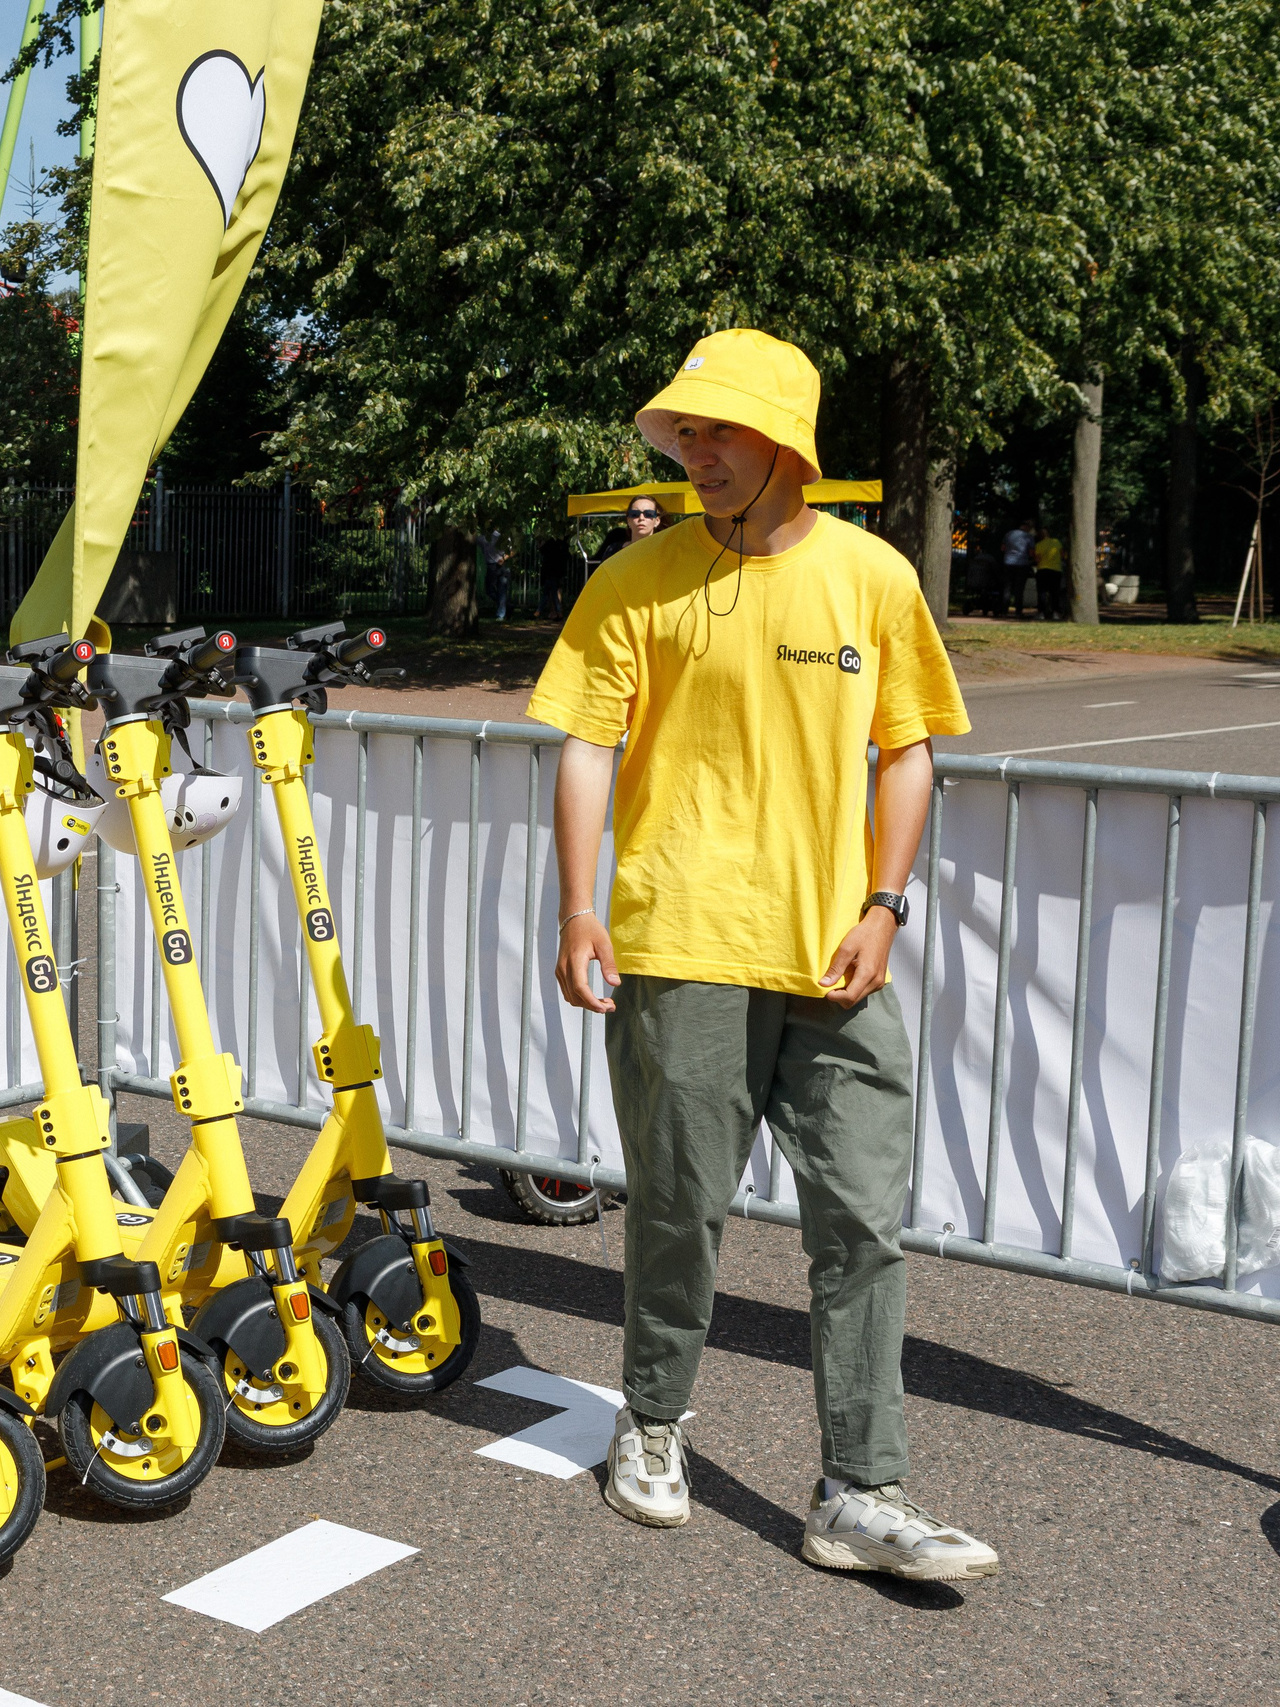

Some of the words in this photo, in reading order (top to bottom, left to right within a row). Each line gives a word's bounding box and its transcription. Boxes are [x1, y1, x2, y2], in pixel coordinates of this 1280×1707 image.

[222, 637, 229, 647] Я
[373, 634, 380, 643] Я
[80, 646, 88, 656] Я
[776, 644, 835, 665] Яндекс
[841, 650, 860, 670] Go
[297, 836, 322, 905] Яндекс
[311, 912, 330, 939] Go
[152, 853, 178, 926] Яндекс
[167, 933, 187, 962] Go
[13, 874, 42, 952] Яндекс
[31, 959, 51, 990] Go
[116, 1213, 147, 1225] Go
